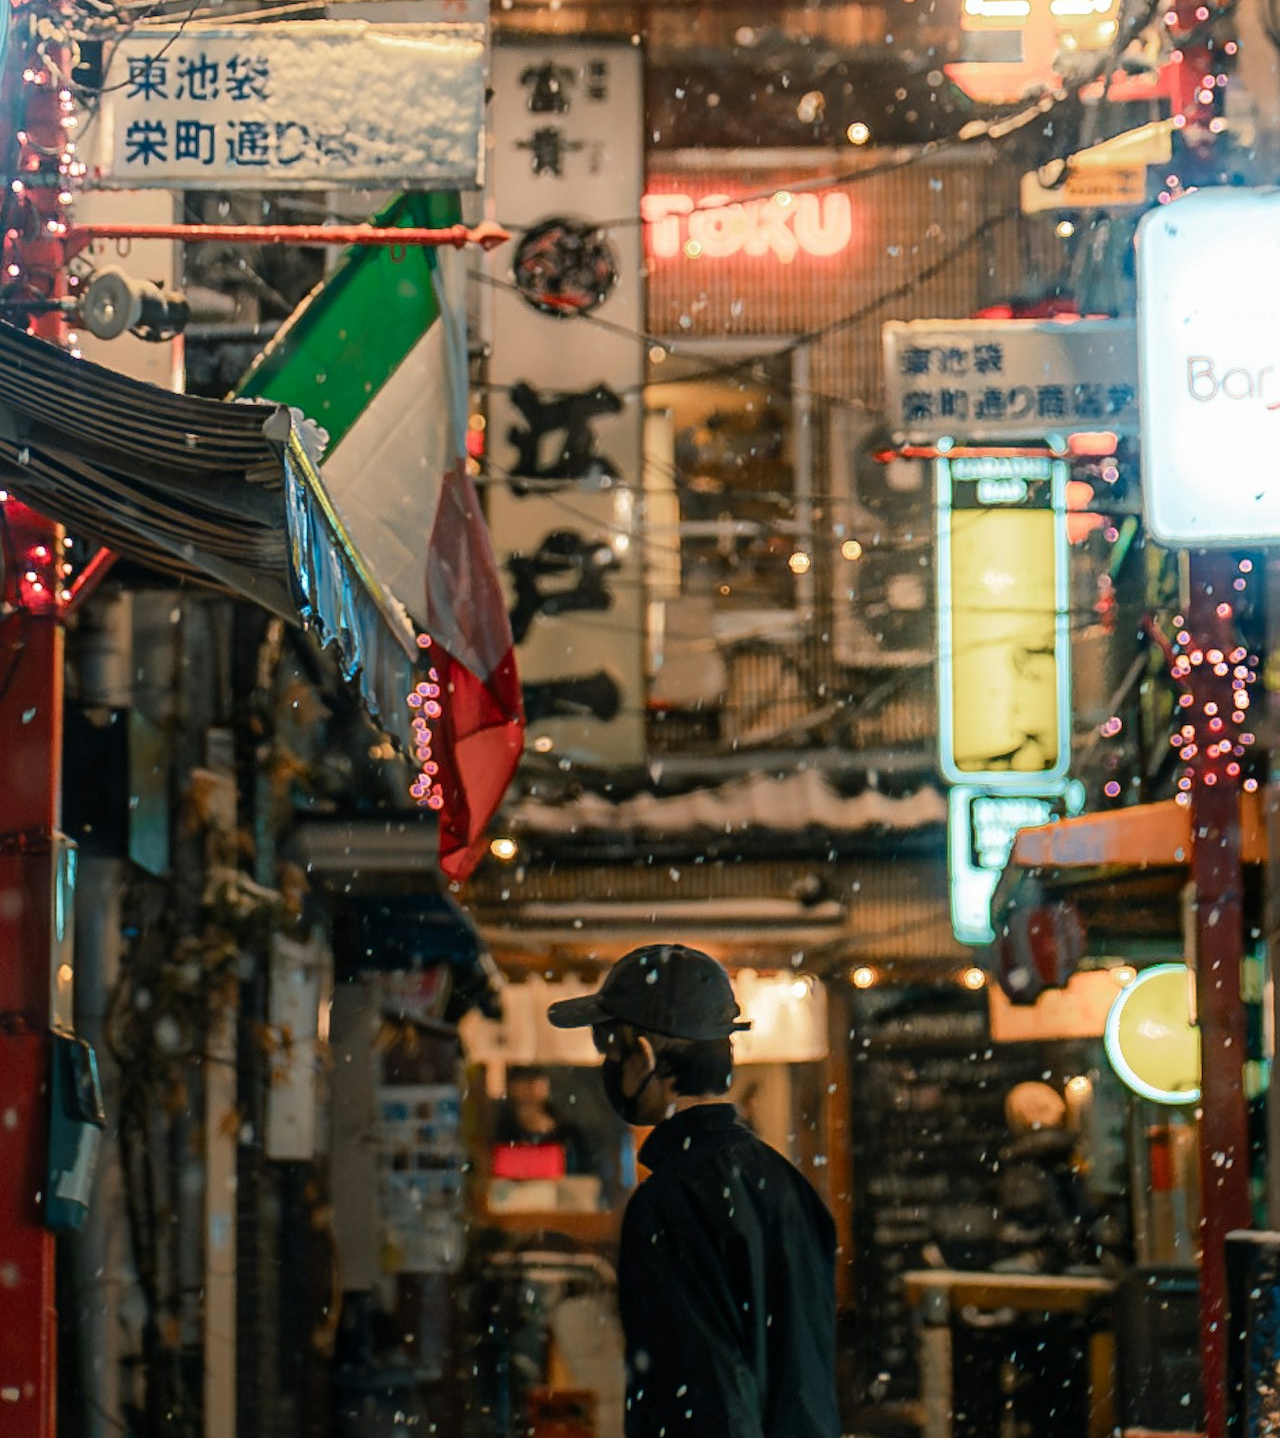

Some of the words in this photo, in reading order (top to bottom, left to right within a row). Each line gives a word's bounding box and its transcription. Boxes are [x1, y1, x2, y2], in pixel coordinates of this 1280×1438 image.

[126, 52, 269, 101] 東池袋
[1187, 355, 1275, 403] Bar
